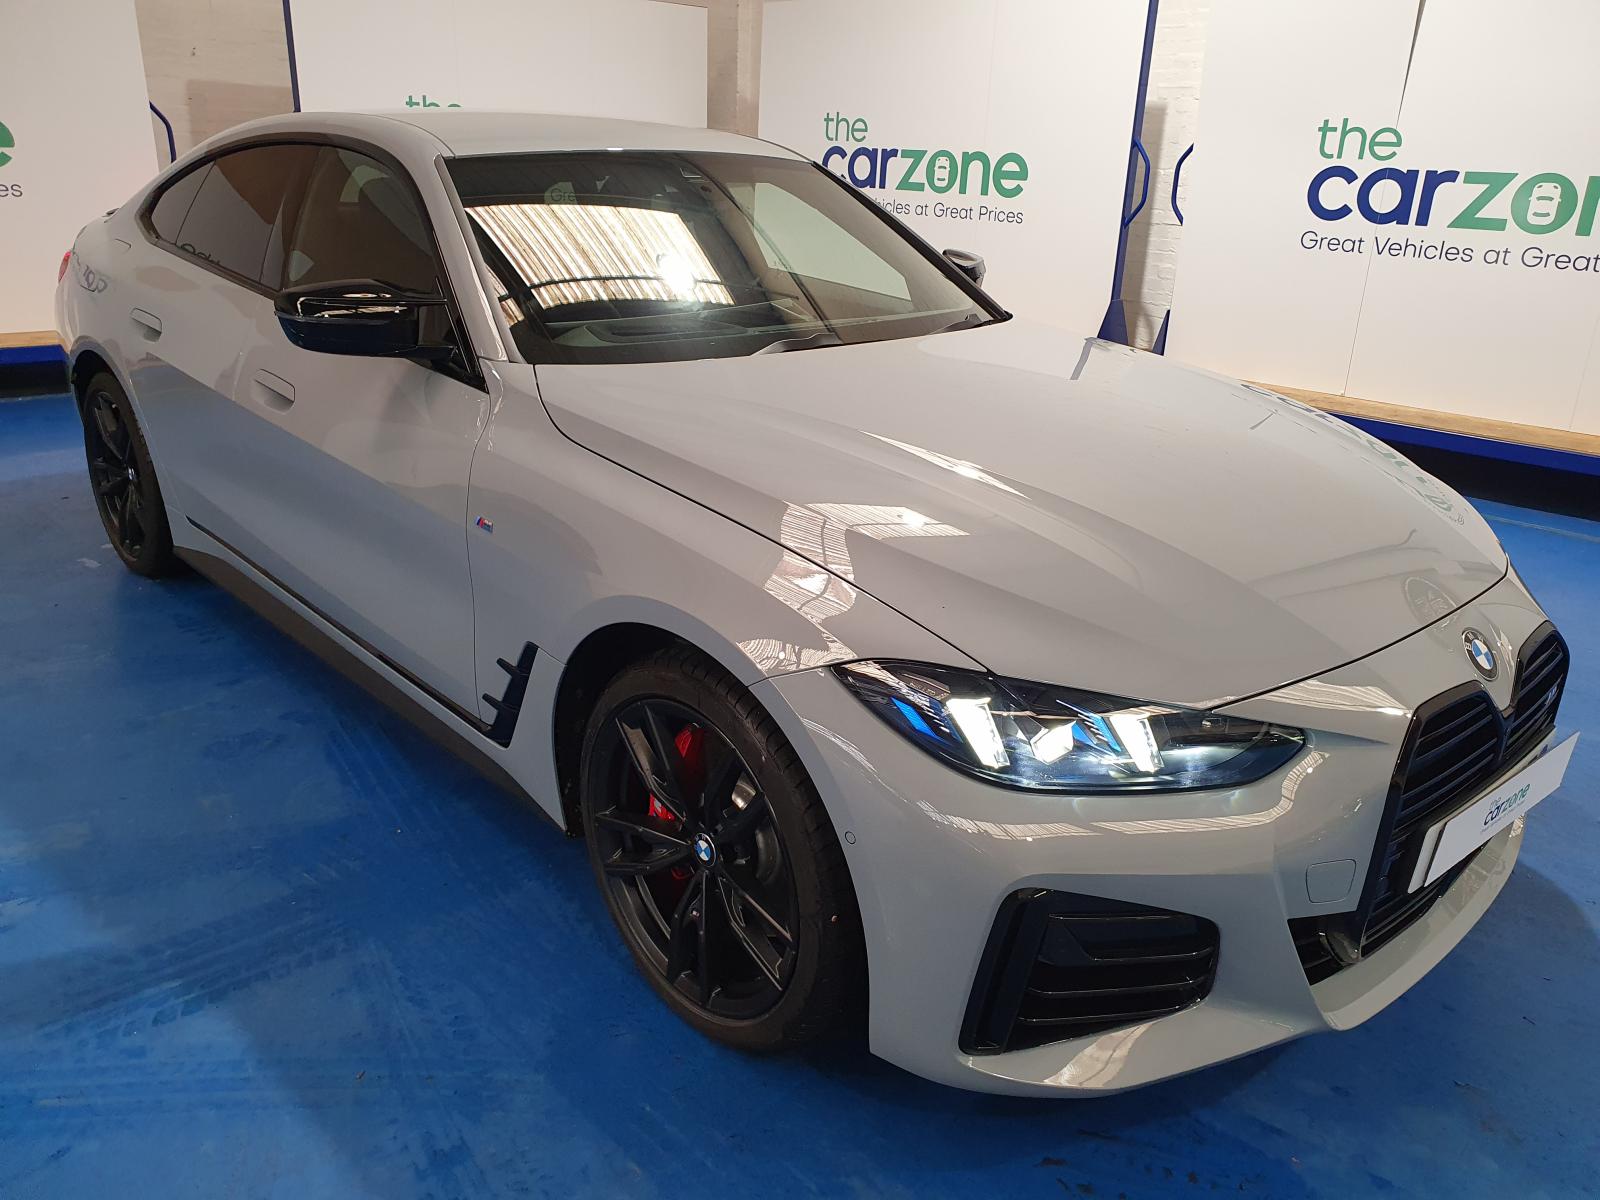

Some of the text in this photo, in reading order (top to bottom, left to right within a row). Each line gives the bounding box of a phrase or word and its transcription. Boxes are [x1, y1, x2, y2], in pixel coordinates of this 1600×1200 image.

[824, 112, 868, 142] the
[1318, 118, 1402, 161] the
[822, 145, 1028, 198] carzone
[914, 202, 929, 217] at
[933, 202, 973, 220] Great
[978, 205, 1024, 225] Prices
[1300, 230, 1600, 273] Great Vehicles at Great
[1484, 783, 1531, 826] carzone
